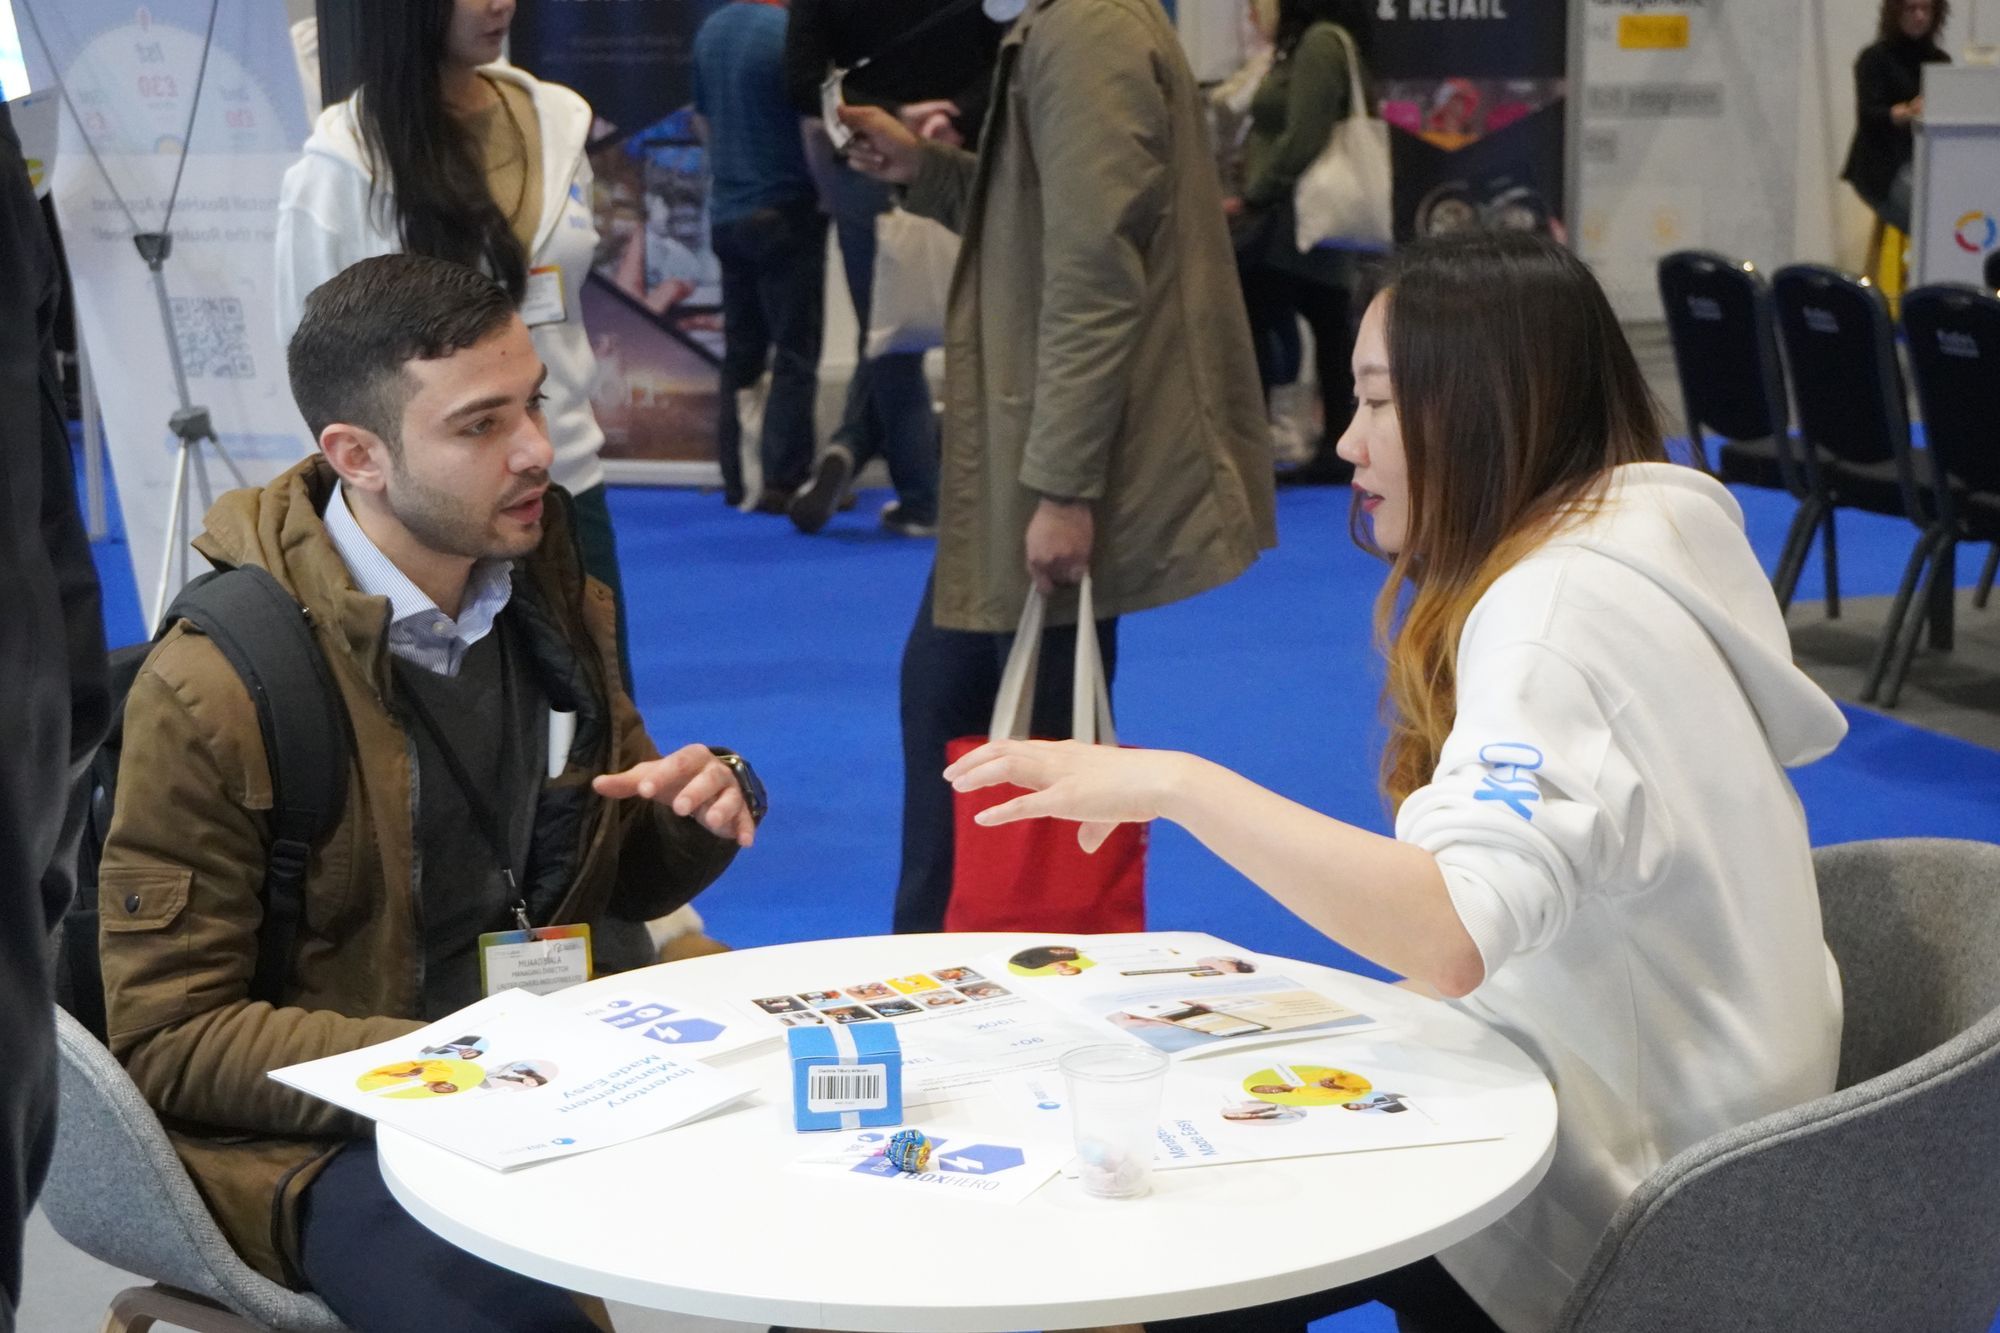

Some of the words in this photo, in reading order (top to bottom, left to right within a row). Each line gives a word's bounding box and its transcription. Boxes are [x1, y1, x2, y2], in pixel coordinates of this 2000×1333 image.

[608, 1053, 662, 1079] Made
[556, 1060, 678, 1113] Management
[563, 1077, 609, 1099] Easy
[607, 1067, 695, 1108] Inventory
